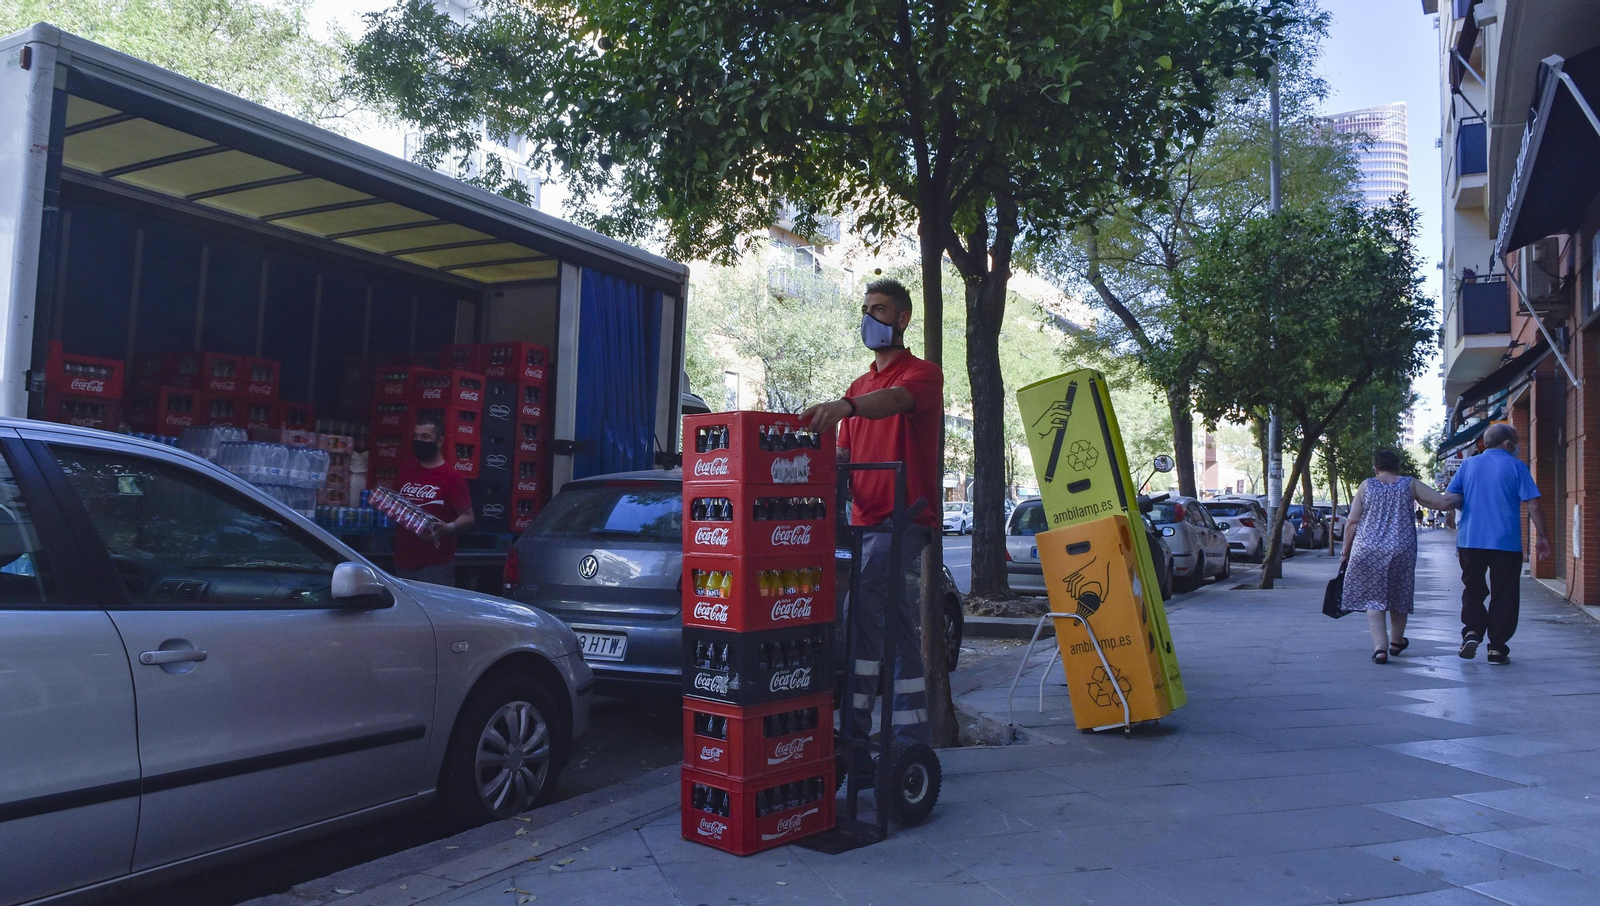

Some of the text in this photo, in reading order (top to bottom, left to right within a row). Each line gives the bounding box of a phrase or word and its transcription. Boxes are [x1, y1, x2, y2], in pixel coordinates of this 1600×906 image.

[694, 457, 729, 477] Coca-Cola
[400, 482, 441, 499] Coca-Cola
[1053, 499, 1113, 524] ambilamp.es
[695, 527, 730, 546] Coca-Cola
[771, 525, 812, 546] Coca-Cola
[694, 601, 729, 622] Coca-Cola
[771, 597, 813, 621] Coca-Cola
[769, 666, 812, 693] Coca-Cola
